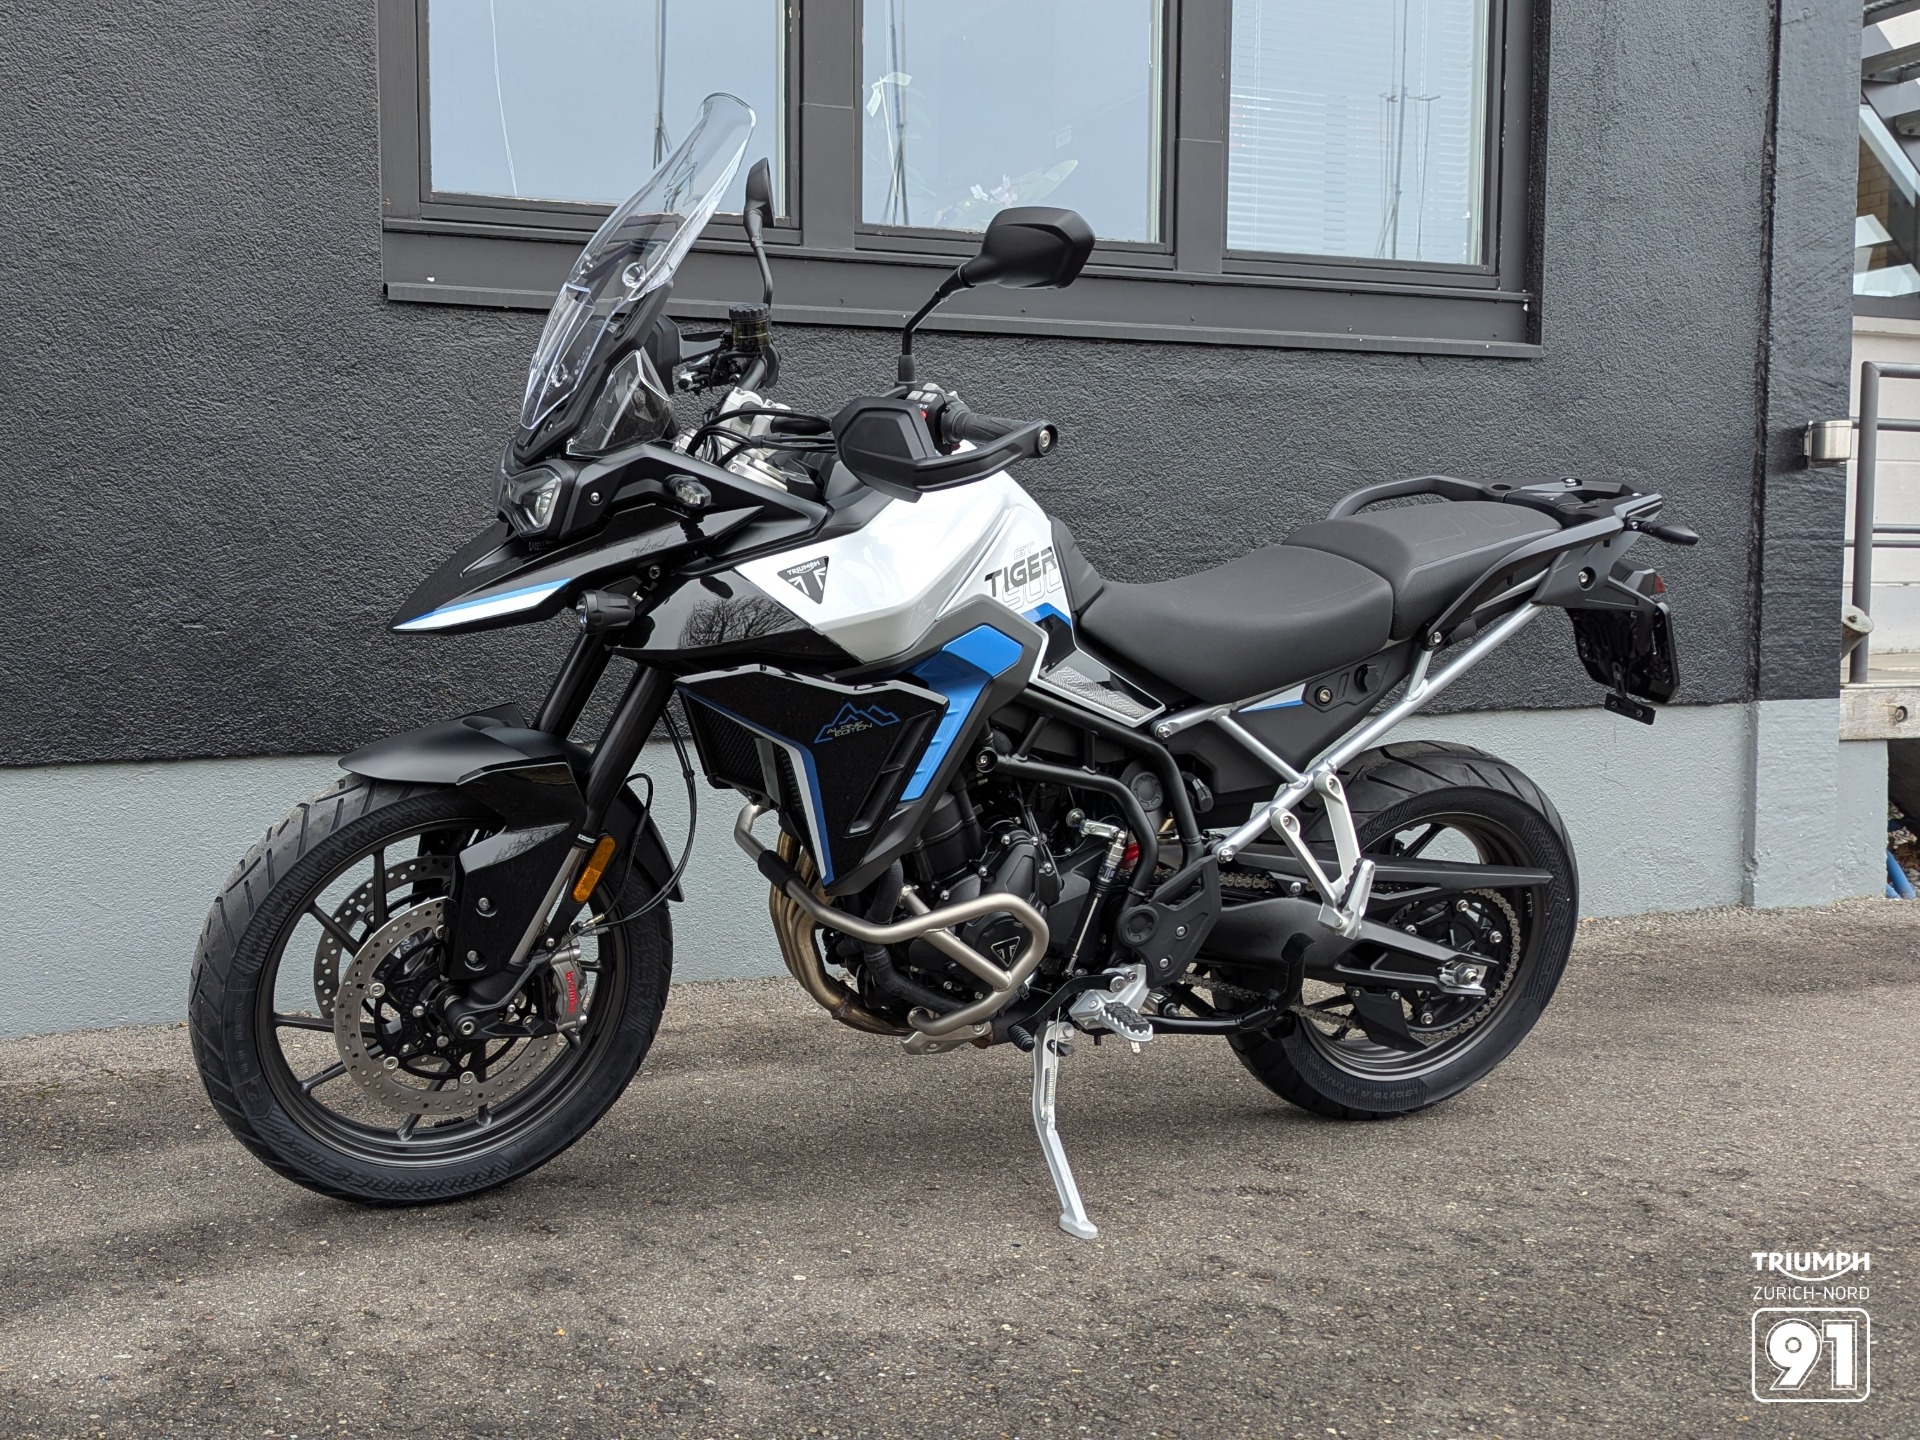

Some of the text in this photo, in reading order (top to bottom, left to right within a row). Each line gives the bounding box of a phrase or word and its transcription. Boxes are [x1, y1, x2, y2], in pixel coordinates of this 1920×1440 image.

[1013, 541, 1035, 561] GT
[786, 560, 821, 576] TRIUMPH
[984, 545, 1058, 598] TIGER
[826, 720, 864, 735] ALPINE
[834, 722, 873, 738] EDITION
